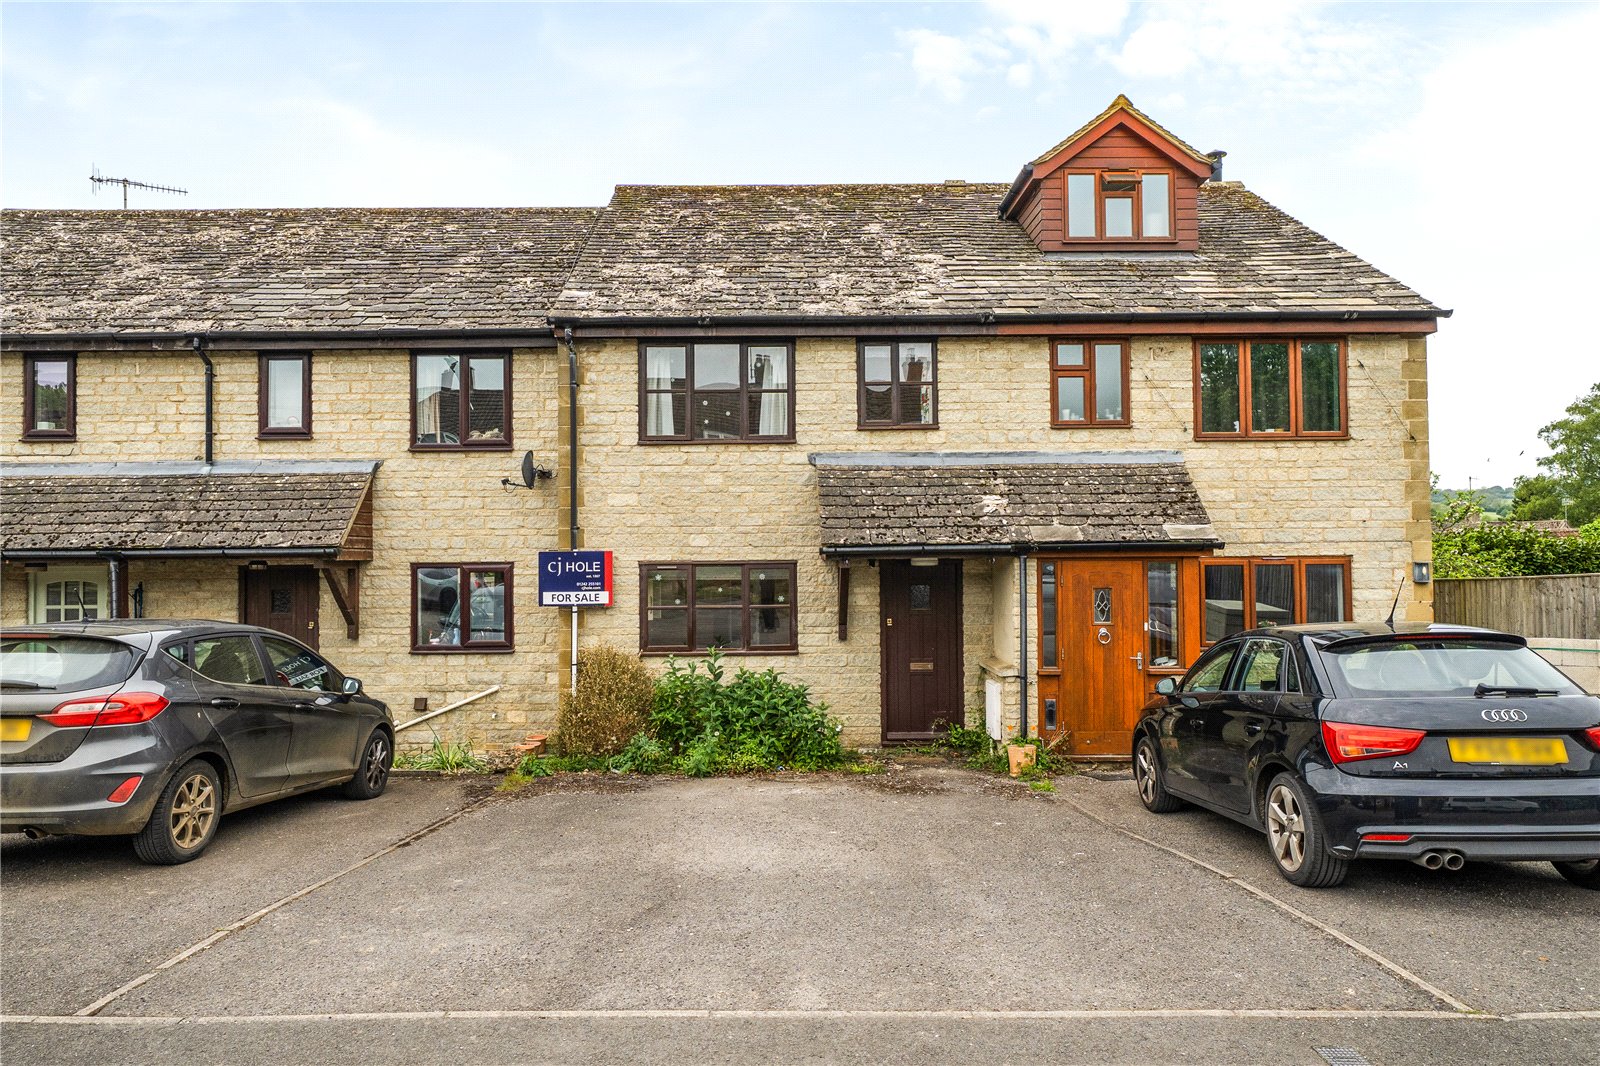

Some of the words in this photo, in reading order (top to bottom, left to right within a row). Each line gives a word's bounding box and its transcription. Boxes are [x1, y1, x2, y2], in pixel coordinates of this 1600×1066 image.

[566, 561, 601, 572] HOLE
[551, 593, 572, 602] FOR
[574, 593, 600, 602] SALE
[1392, 761, 1408, 769] A1
